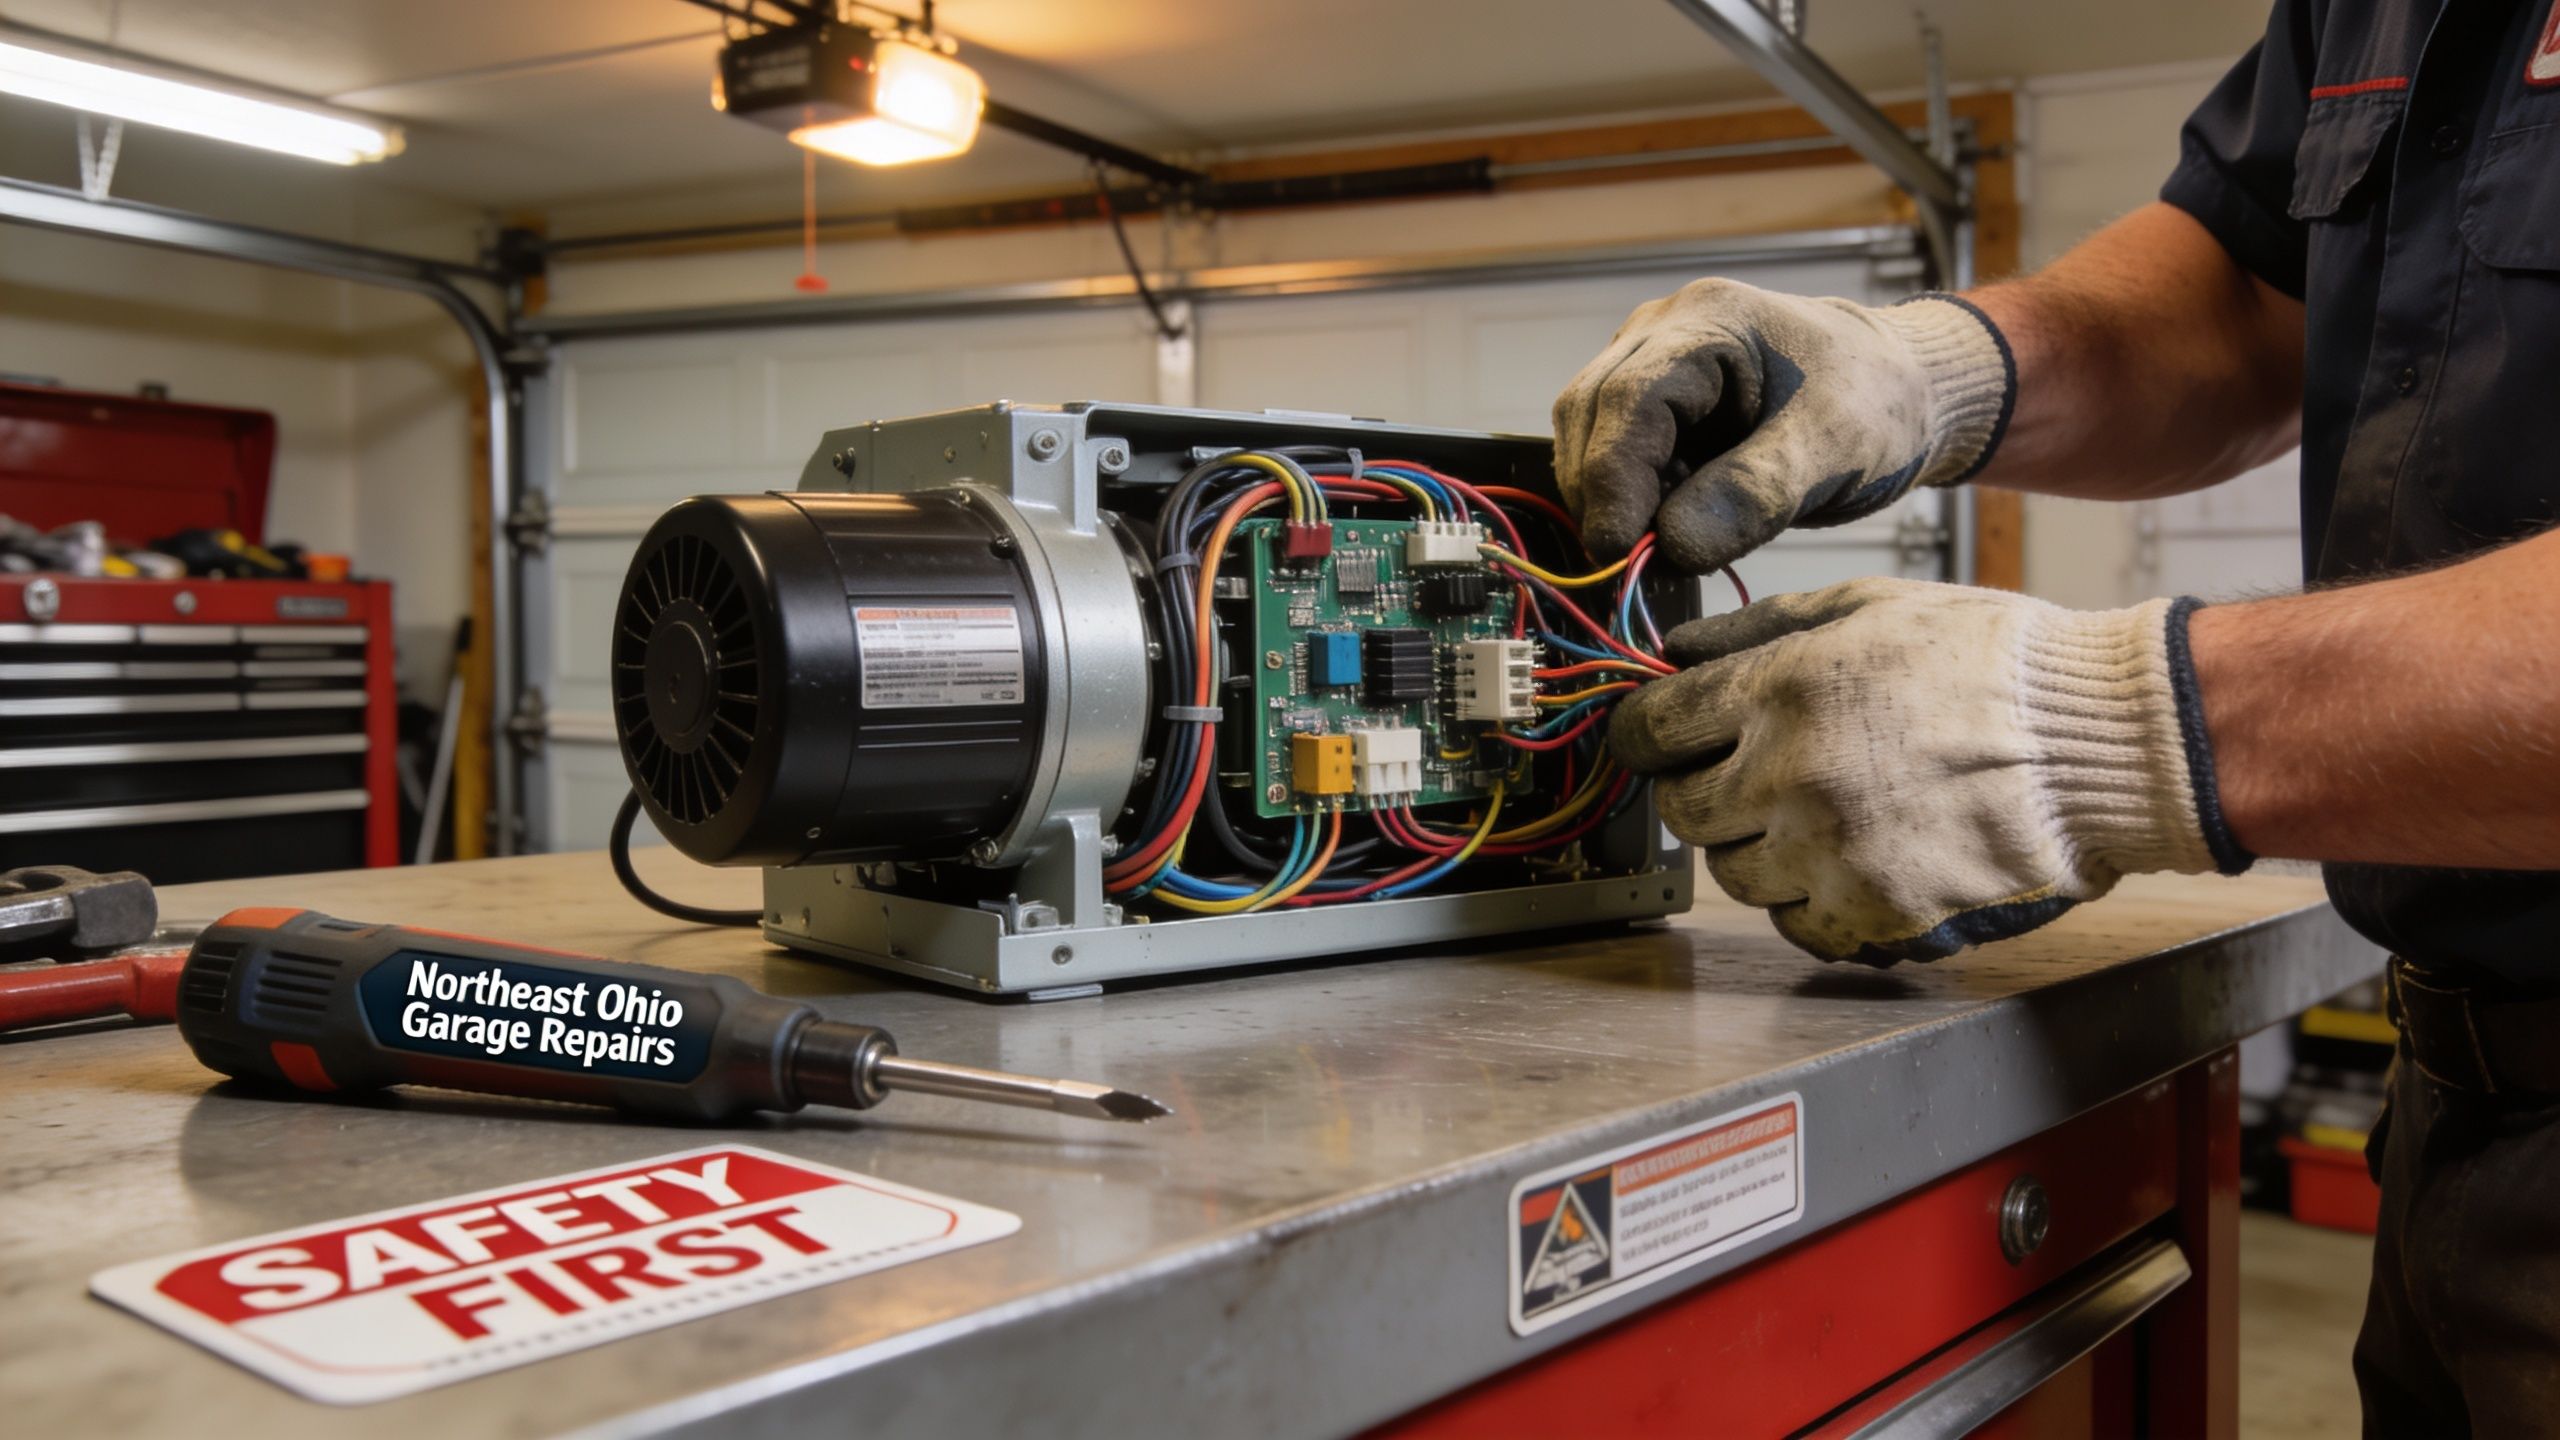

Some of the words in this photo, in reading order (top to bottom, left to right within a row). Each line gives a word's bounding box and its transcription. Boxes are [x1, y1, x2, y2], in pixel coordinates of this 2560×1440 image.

[402, 1002, 530, 1055] Garage
[540, 1018, 675, 1067] Repairs
[407, 960, 589, 1016] Northeast
[597, 984, 683, 1027] Ohio
[219, 1156, 748, 1310] SAFETY
[410, 1206, 831, 1341] FIRST
